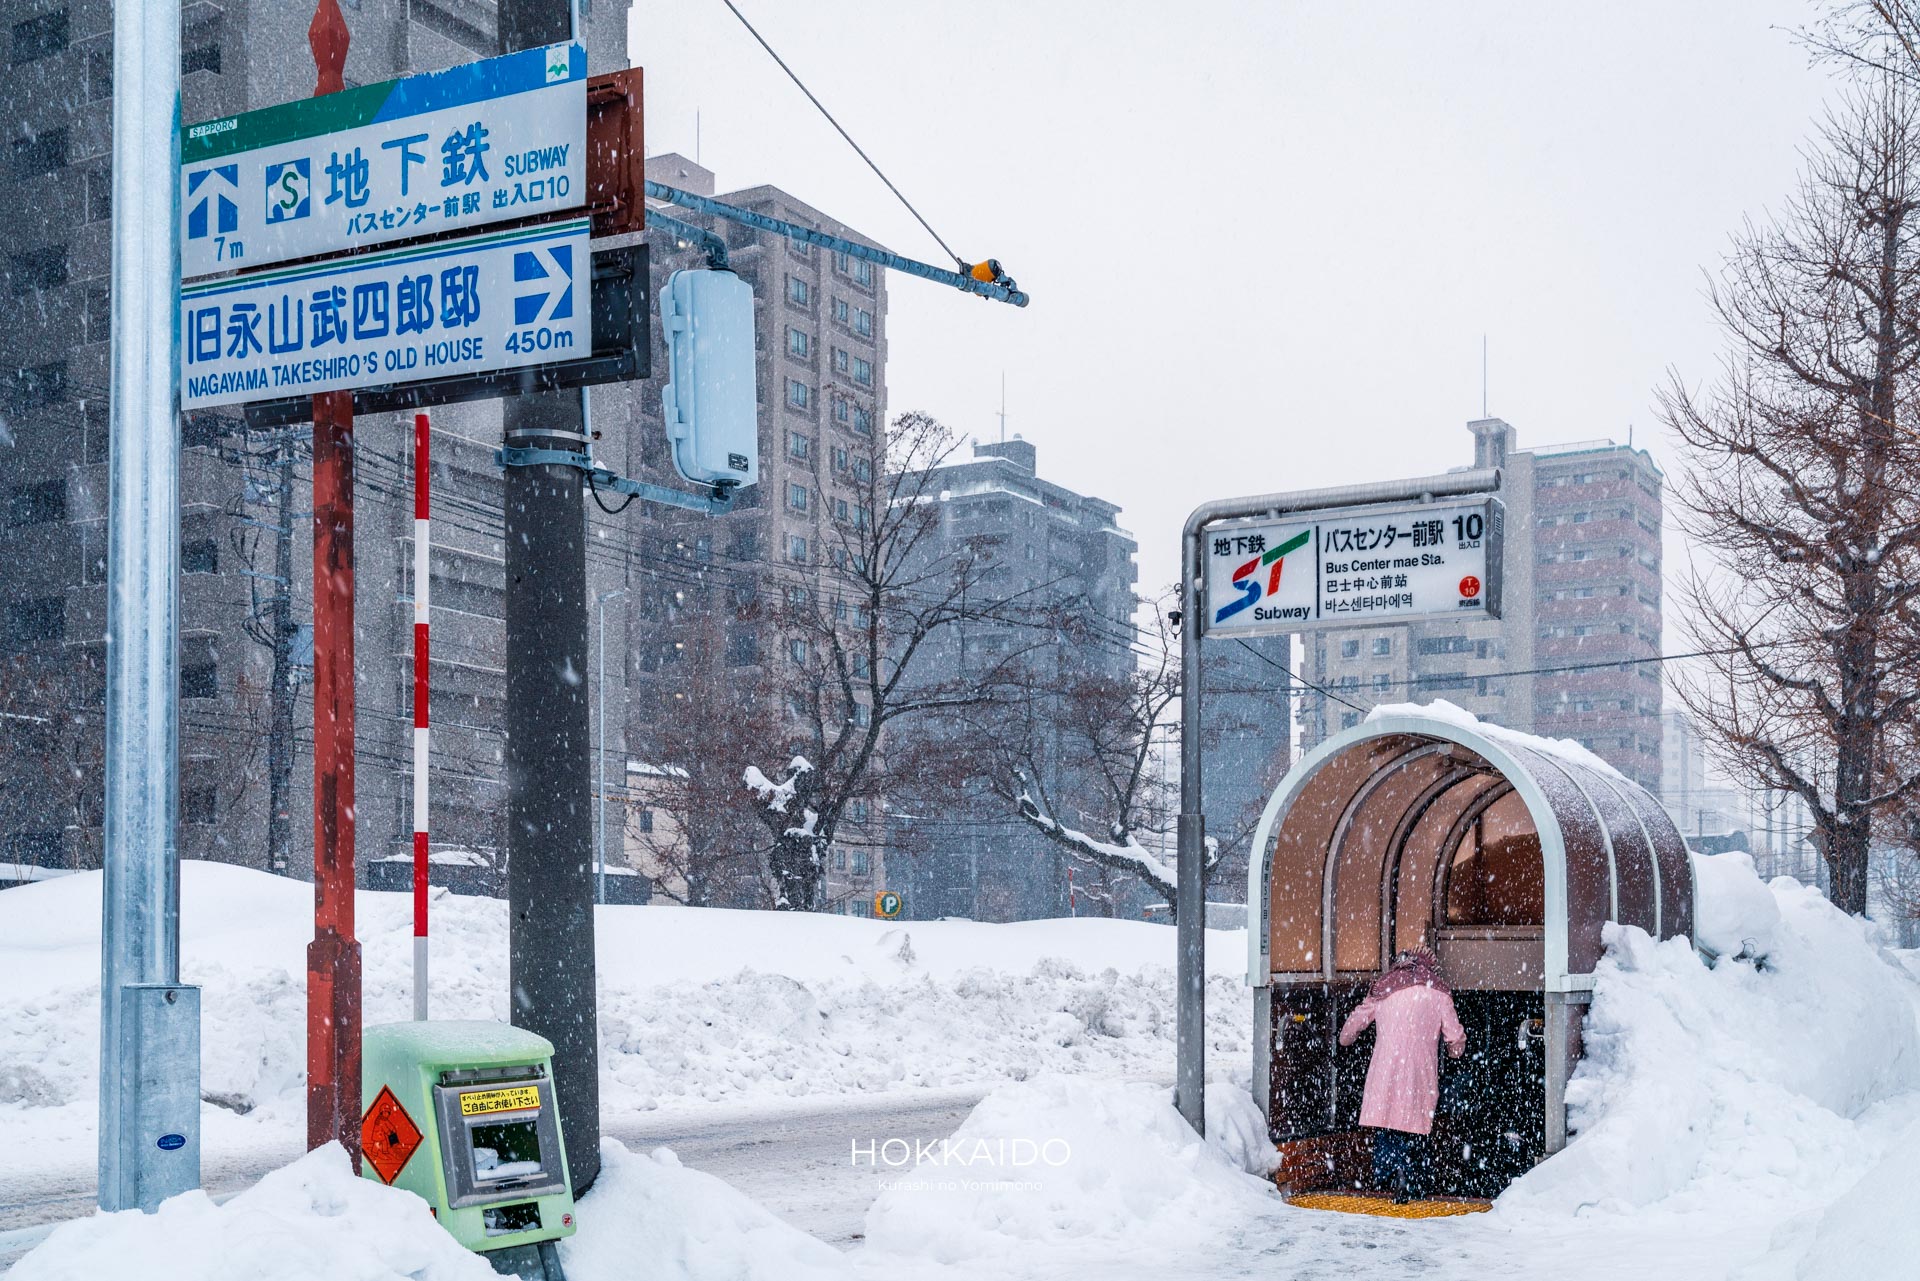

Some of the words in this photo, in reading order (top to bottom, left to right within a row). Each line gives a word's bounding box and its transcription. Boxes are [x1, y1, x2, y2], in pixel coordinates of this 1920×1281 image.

[193, 120, 234, 137] SAPPORO
[324, 121, 491, 208] 地下鉄
[504, 143, 570, 178] SUBWAY
[346, 191, 481, 236] バスセンター前駅
[492, 175, 570, 209] 出入口10
[187, 264, 481, 366] 旧永山武四郎邸
[505, 327, 573, 354] 450m
[188, 367, 269, 398] NAGAYAMA
[271, 350, 378, 387] TAKESHIRO'S
[384, 347, 418, 371] OLD
[425, 337, 483, 366] HOUSE
[1324, 520, 1444, 553] バスセンター前駅
[1452, 513, 1483, 541] 10
[1213, 535, 1266, 556] 地下鉄
[1458, 541, 1480, 550] 出入口
[1326, 562, 1349, 574] Bus
[1351, 558, 1390, 572] Center
[1393, 556, 1419, 569] mae
[1421, 553, 1445, 566] Sta.
[1326, 573, 1408, 593] 巴士中心前站
[1464, 587, 1475, 596] 10
[1466, 578, 1473, 586] T
[1325, 592, 1413, 613] 바스센타마에역
[1254, 606, 1311, 621] Subway
[885, 896, 897, 913] P
[463, 1096, 539, 1113] ご自由にお使い下さい
